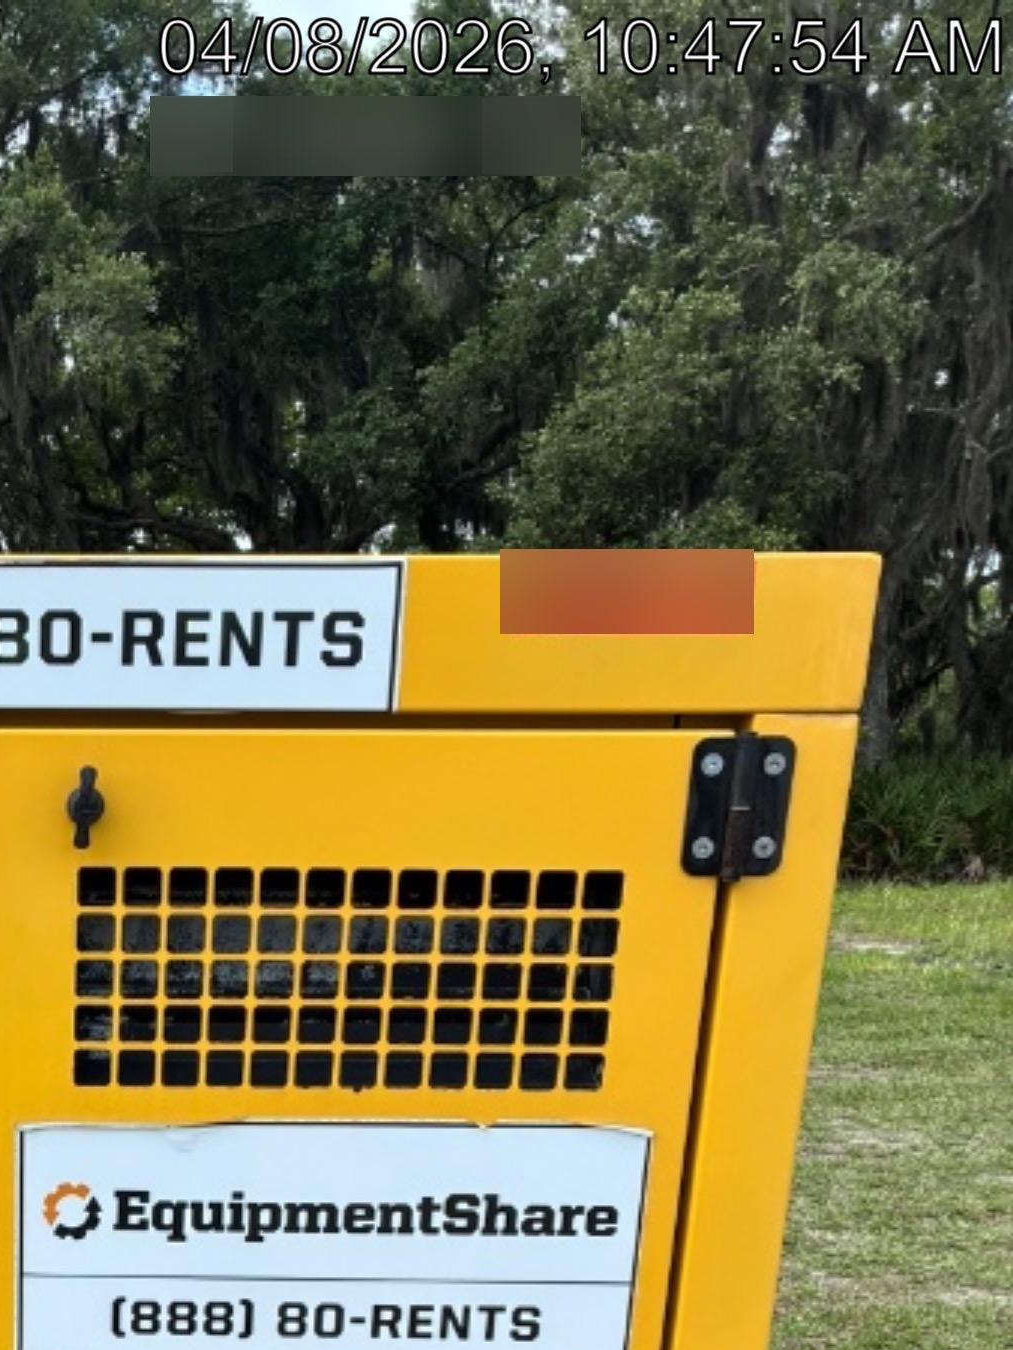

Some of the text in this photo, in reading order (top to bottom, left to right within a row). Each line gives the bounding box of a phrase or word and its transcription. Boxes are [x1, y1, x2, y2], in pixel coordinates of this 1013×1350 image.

[113, 1190, 619, 1243] EquipmentShare
[112, 1297, 542, 1342] (888) 80-RENTS
